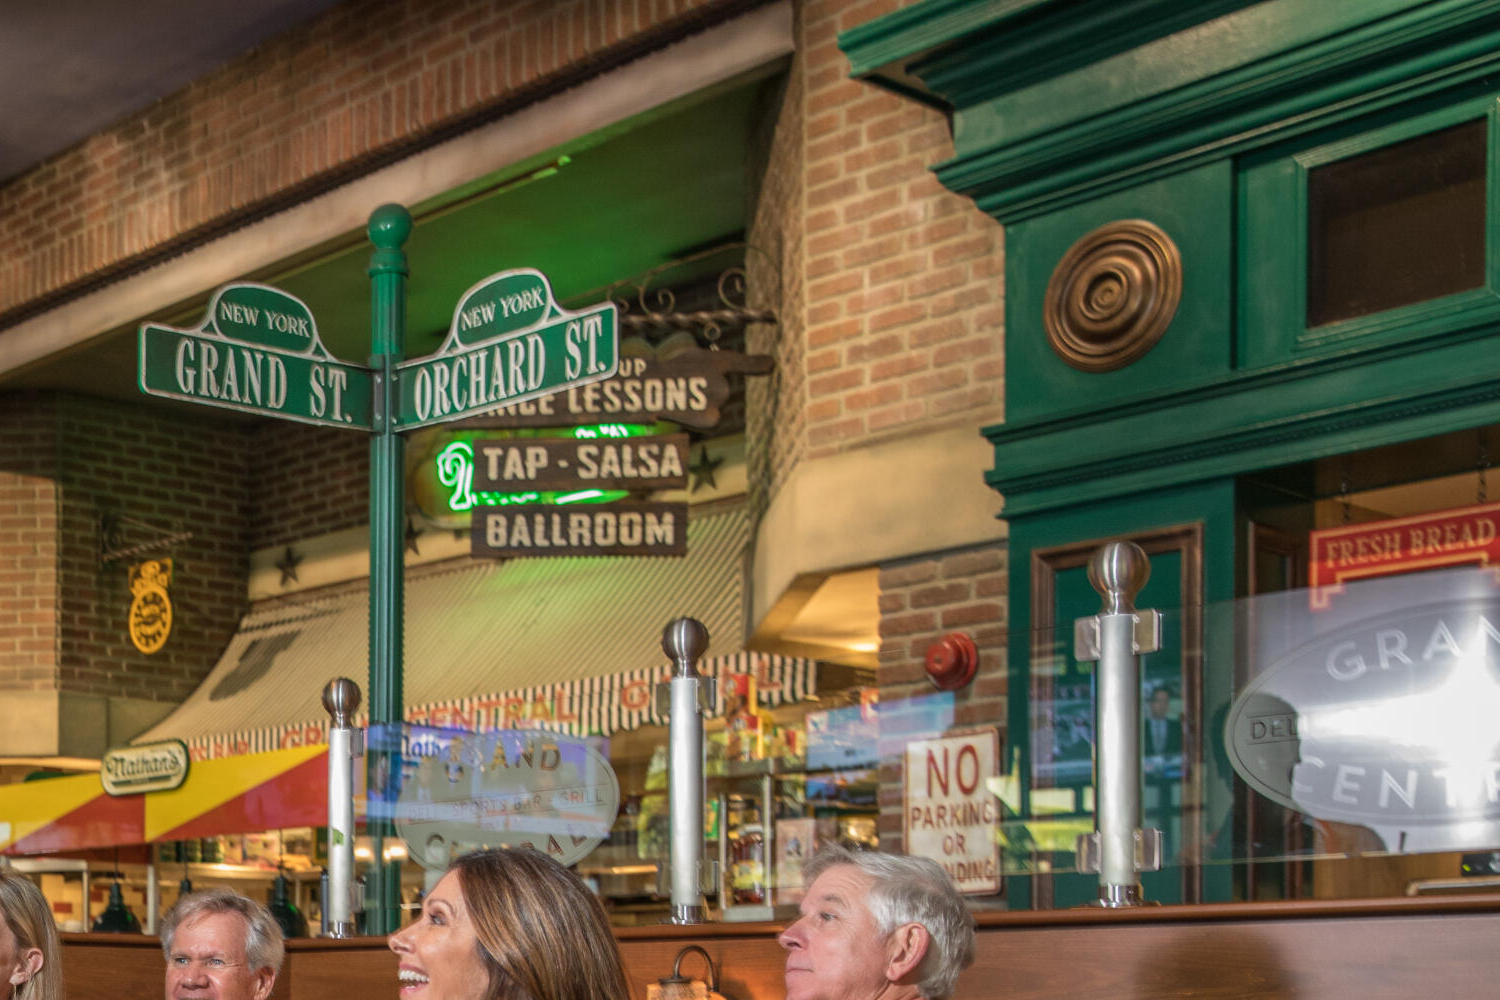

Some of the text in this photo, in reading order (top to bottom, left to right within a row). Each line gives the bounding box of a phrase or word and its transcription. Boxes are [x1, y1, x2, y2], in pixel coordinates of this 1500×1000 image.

[220, 301, 311, 338] NEW YORK
[461, 285, 545, 331] NEW YORK
[175, 337, 353, 423] GRAND ST.
[414, 314, 607, 422] ORCHARD ST.
[567, 376, 708, 413] LESSONS
[483, 446, 548, 481] TAP
[577, 444, 684, 480] SALSA
[486, 511, 676, 548] BALLROOM
[1325, 517, 1497, 569] FRESH BREAD
[1251, 718, 1298, 740] DEL
[926, 744, 980, 798] NO
[911, 800, 994, 830] PARKING
[943, 832, 967, 856] OR
